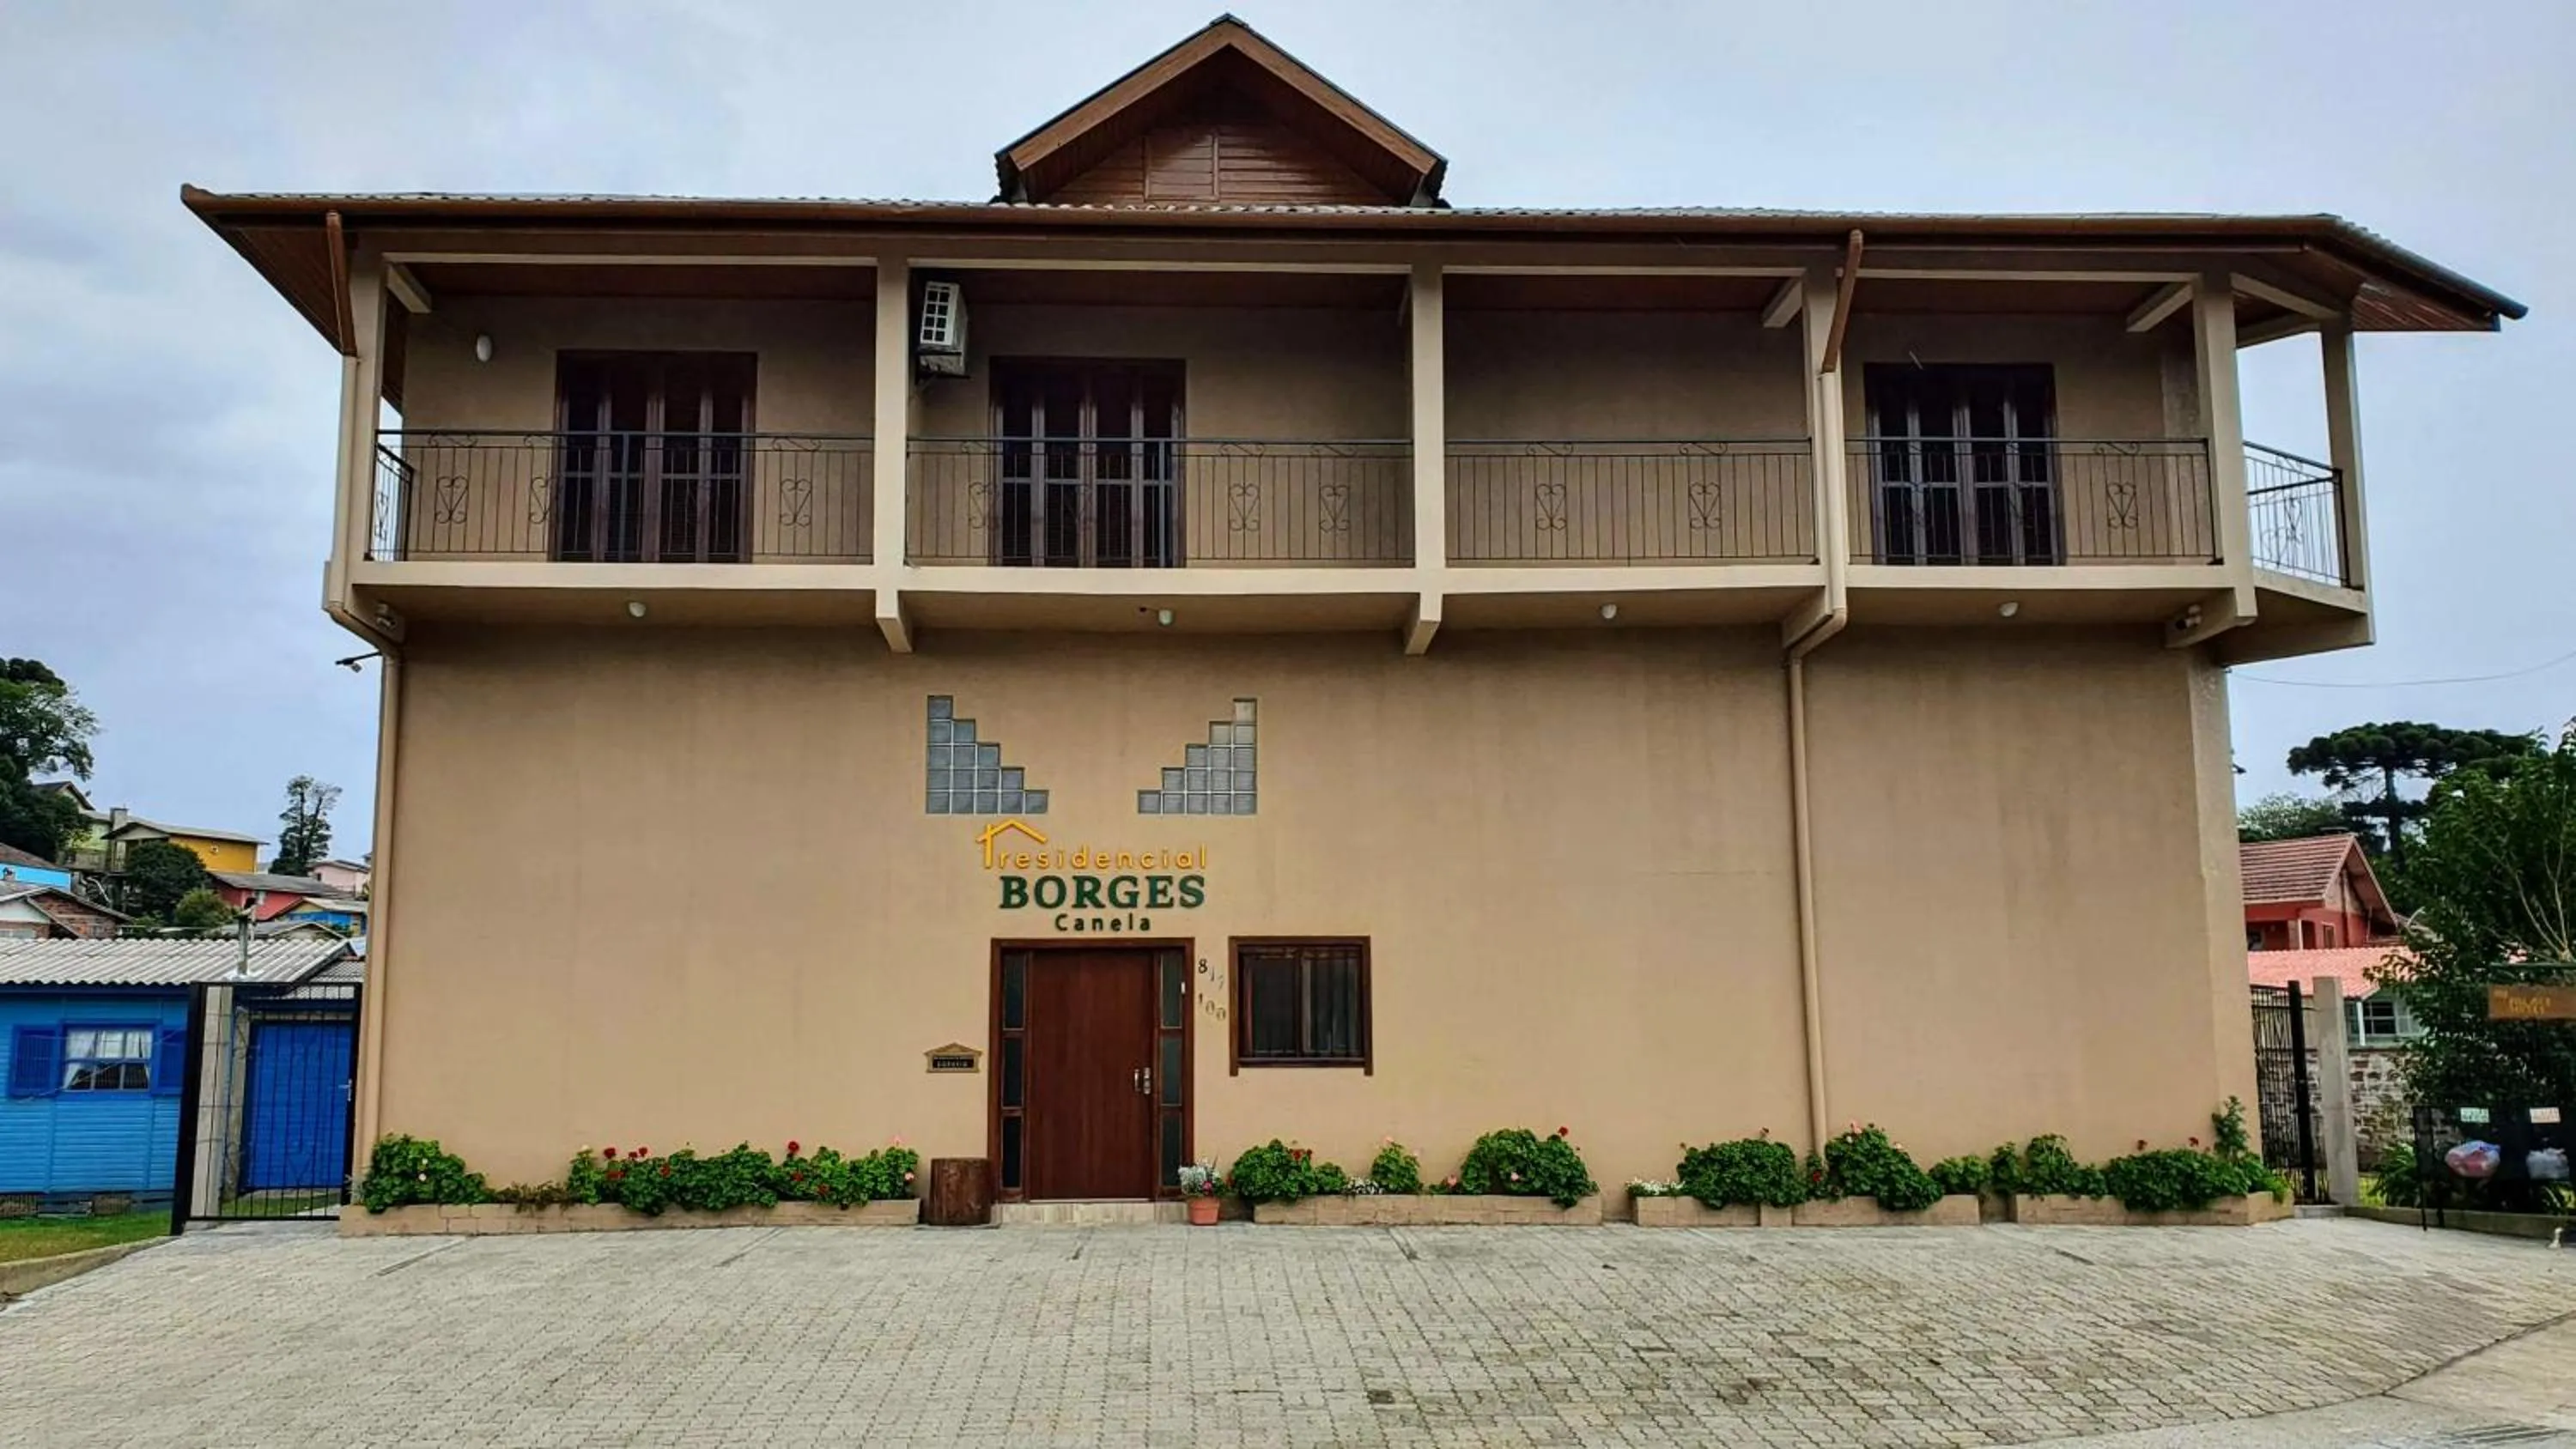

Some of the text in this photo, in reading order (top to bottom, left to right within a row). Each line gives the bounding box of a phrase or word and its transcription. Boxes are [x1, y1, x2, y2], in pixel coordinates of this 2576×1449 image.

[999, 844, 1207, 870] residencial
[999, 875, 1206, 910] BORGES
[1054, 913, 1151, 931] Canela
